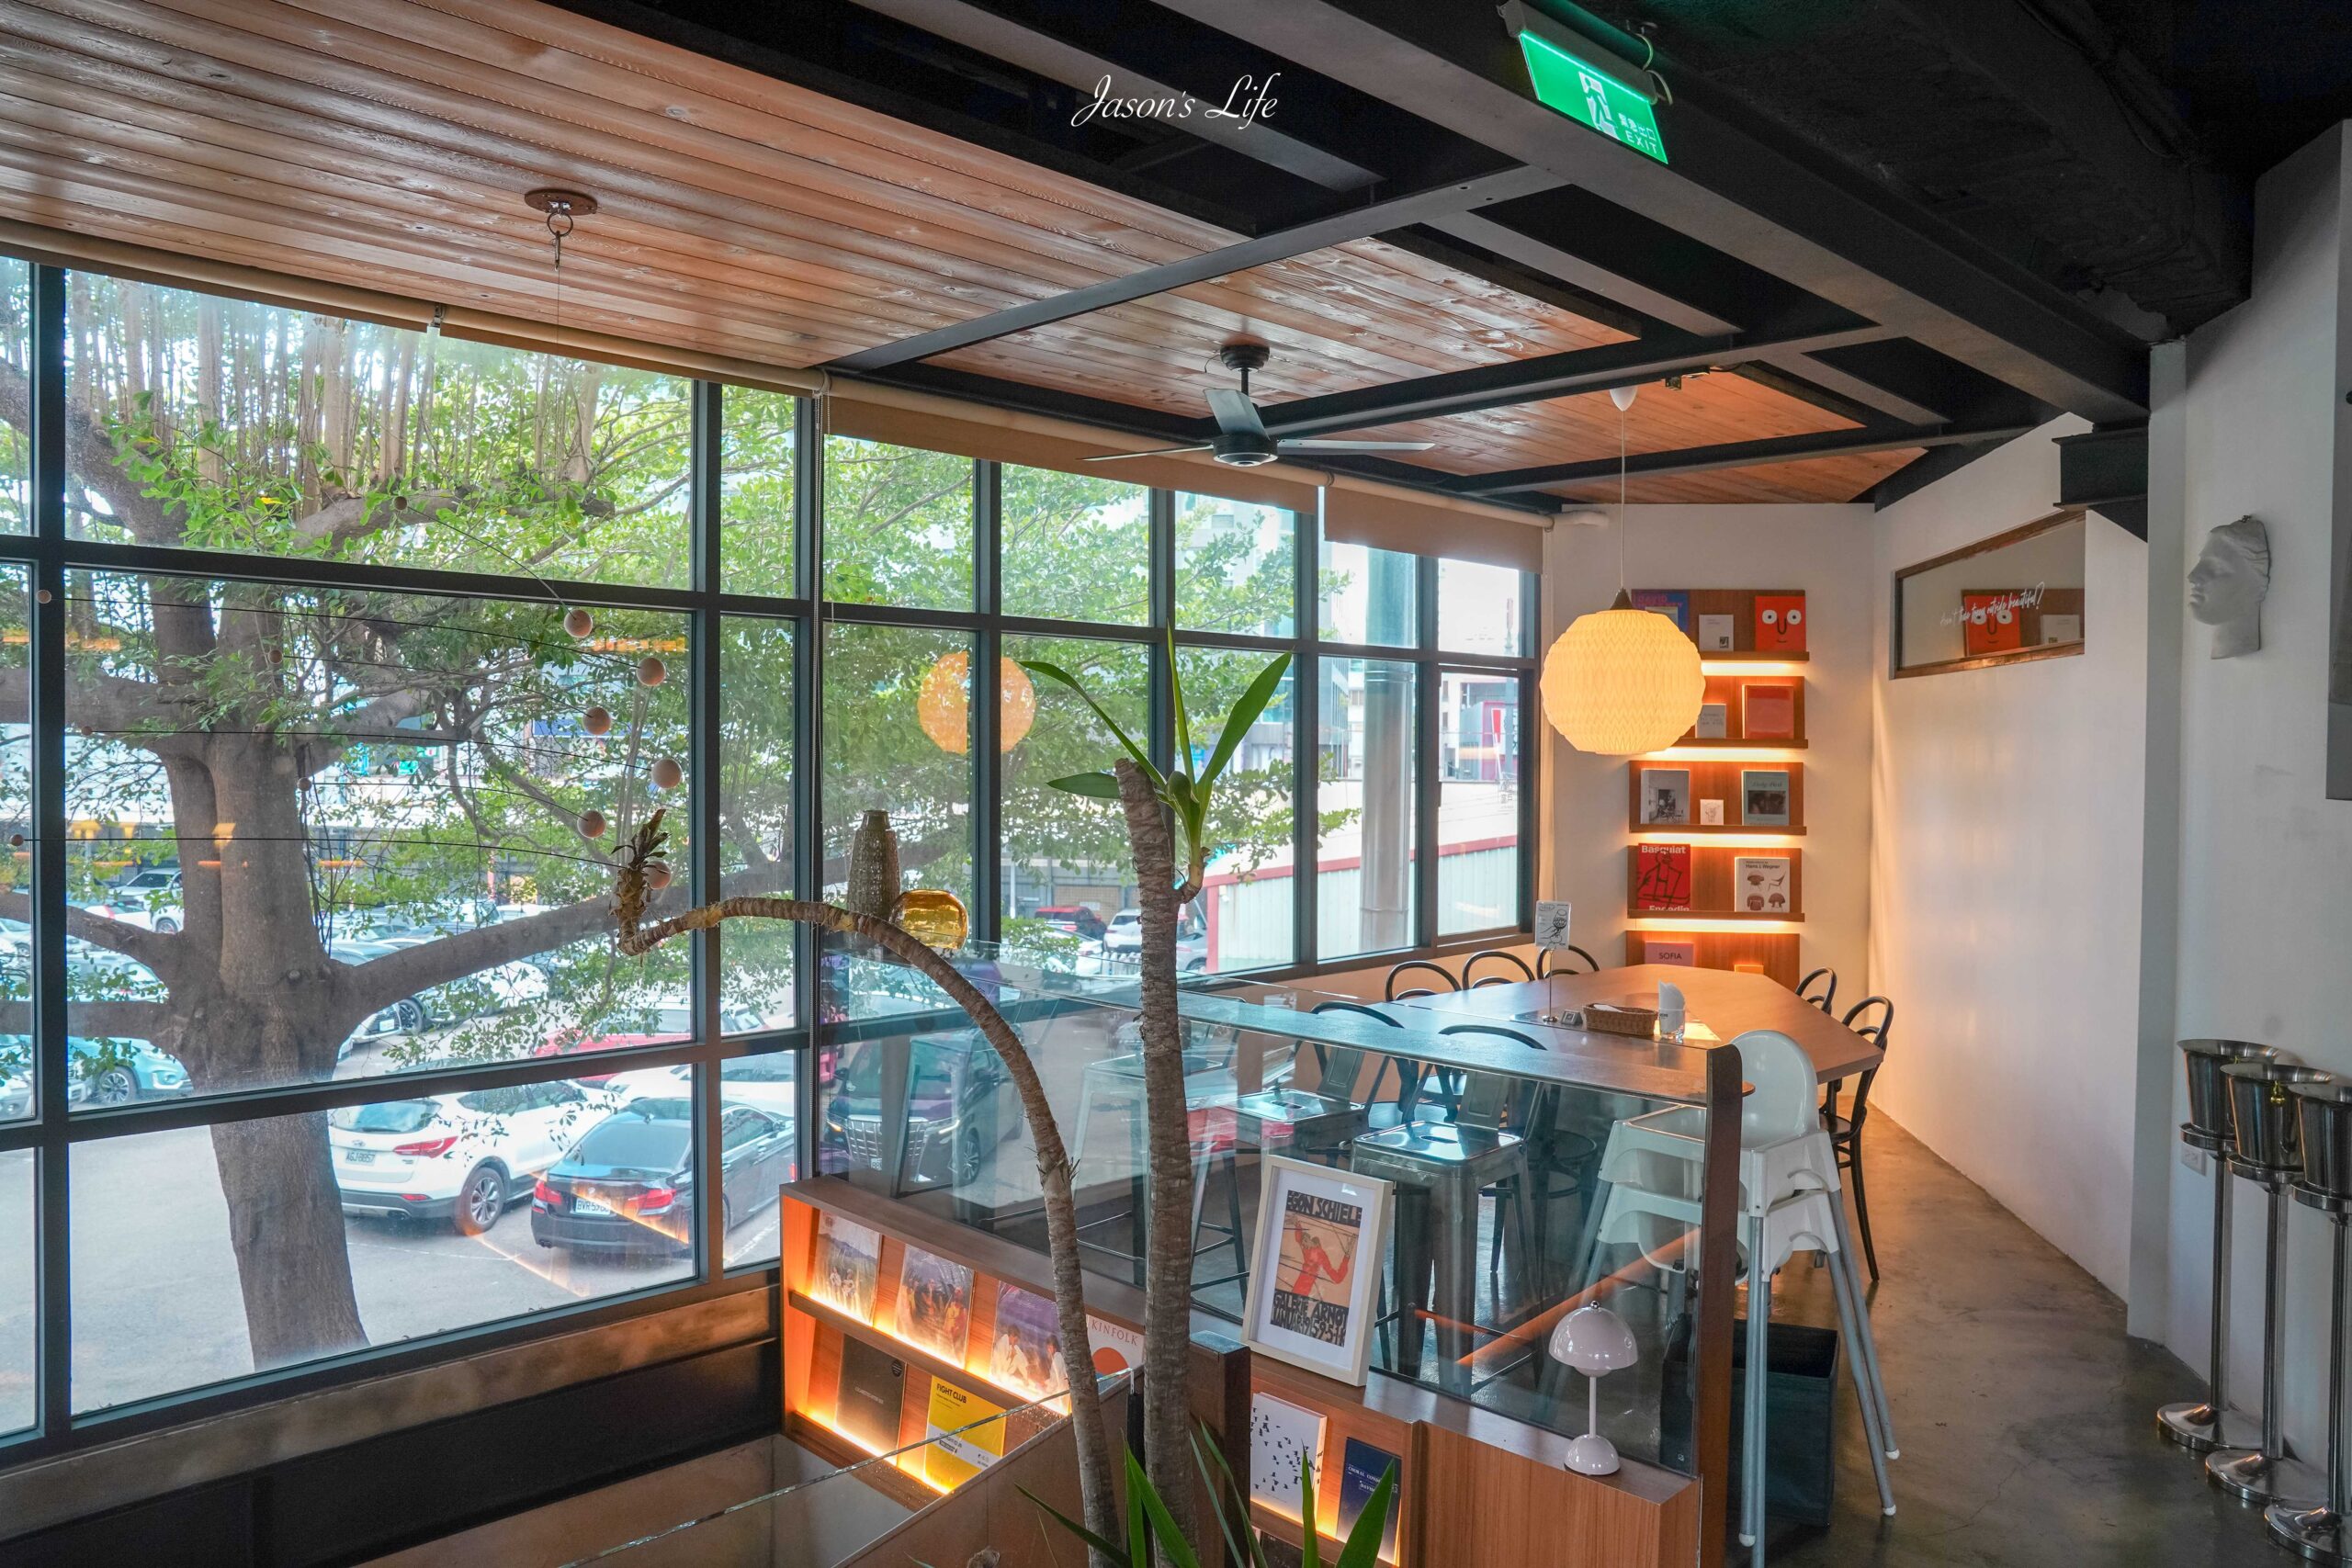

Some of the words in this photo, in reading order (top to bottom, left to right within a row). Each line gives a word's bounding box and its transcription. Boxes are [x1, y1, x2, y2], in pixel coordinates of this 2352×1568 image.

[1624, 130, 1657, 154] EXIT
[1641, 845, 1687, 855] Basquiat
[1658, 952, 1682, 960] SOFIA
[1315, 1197, 1363, 1224] SCHIELE
[1091, 1319, 1139, 1346] KINFOLK
[936, 1382, 953, 1397] FIGHT
[952, 1391, 967, 1404] CLUB
